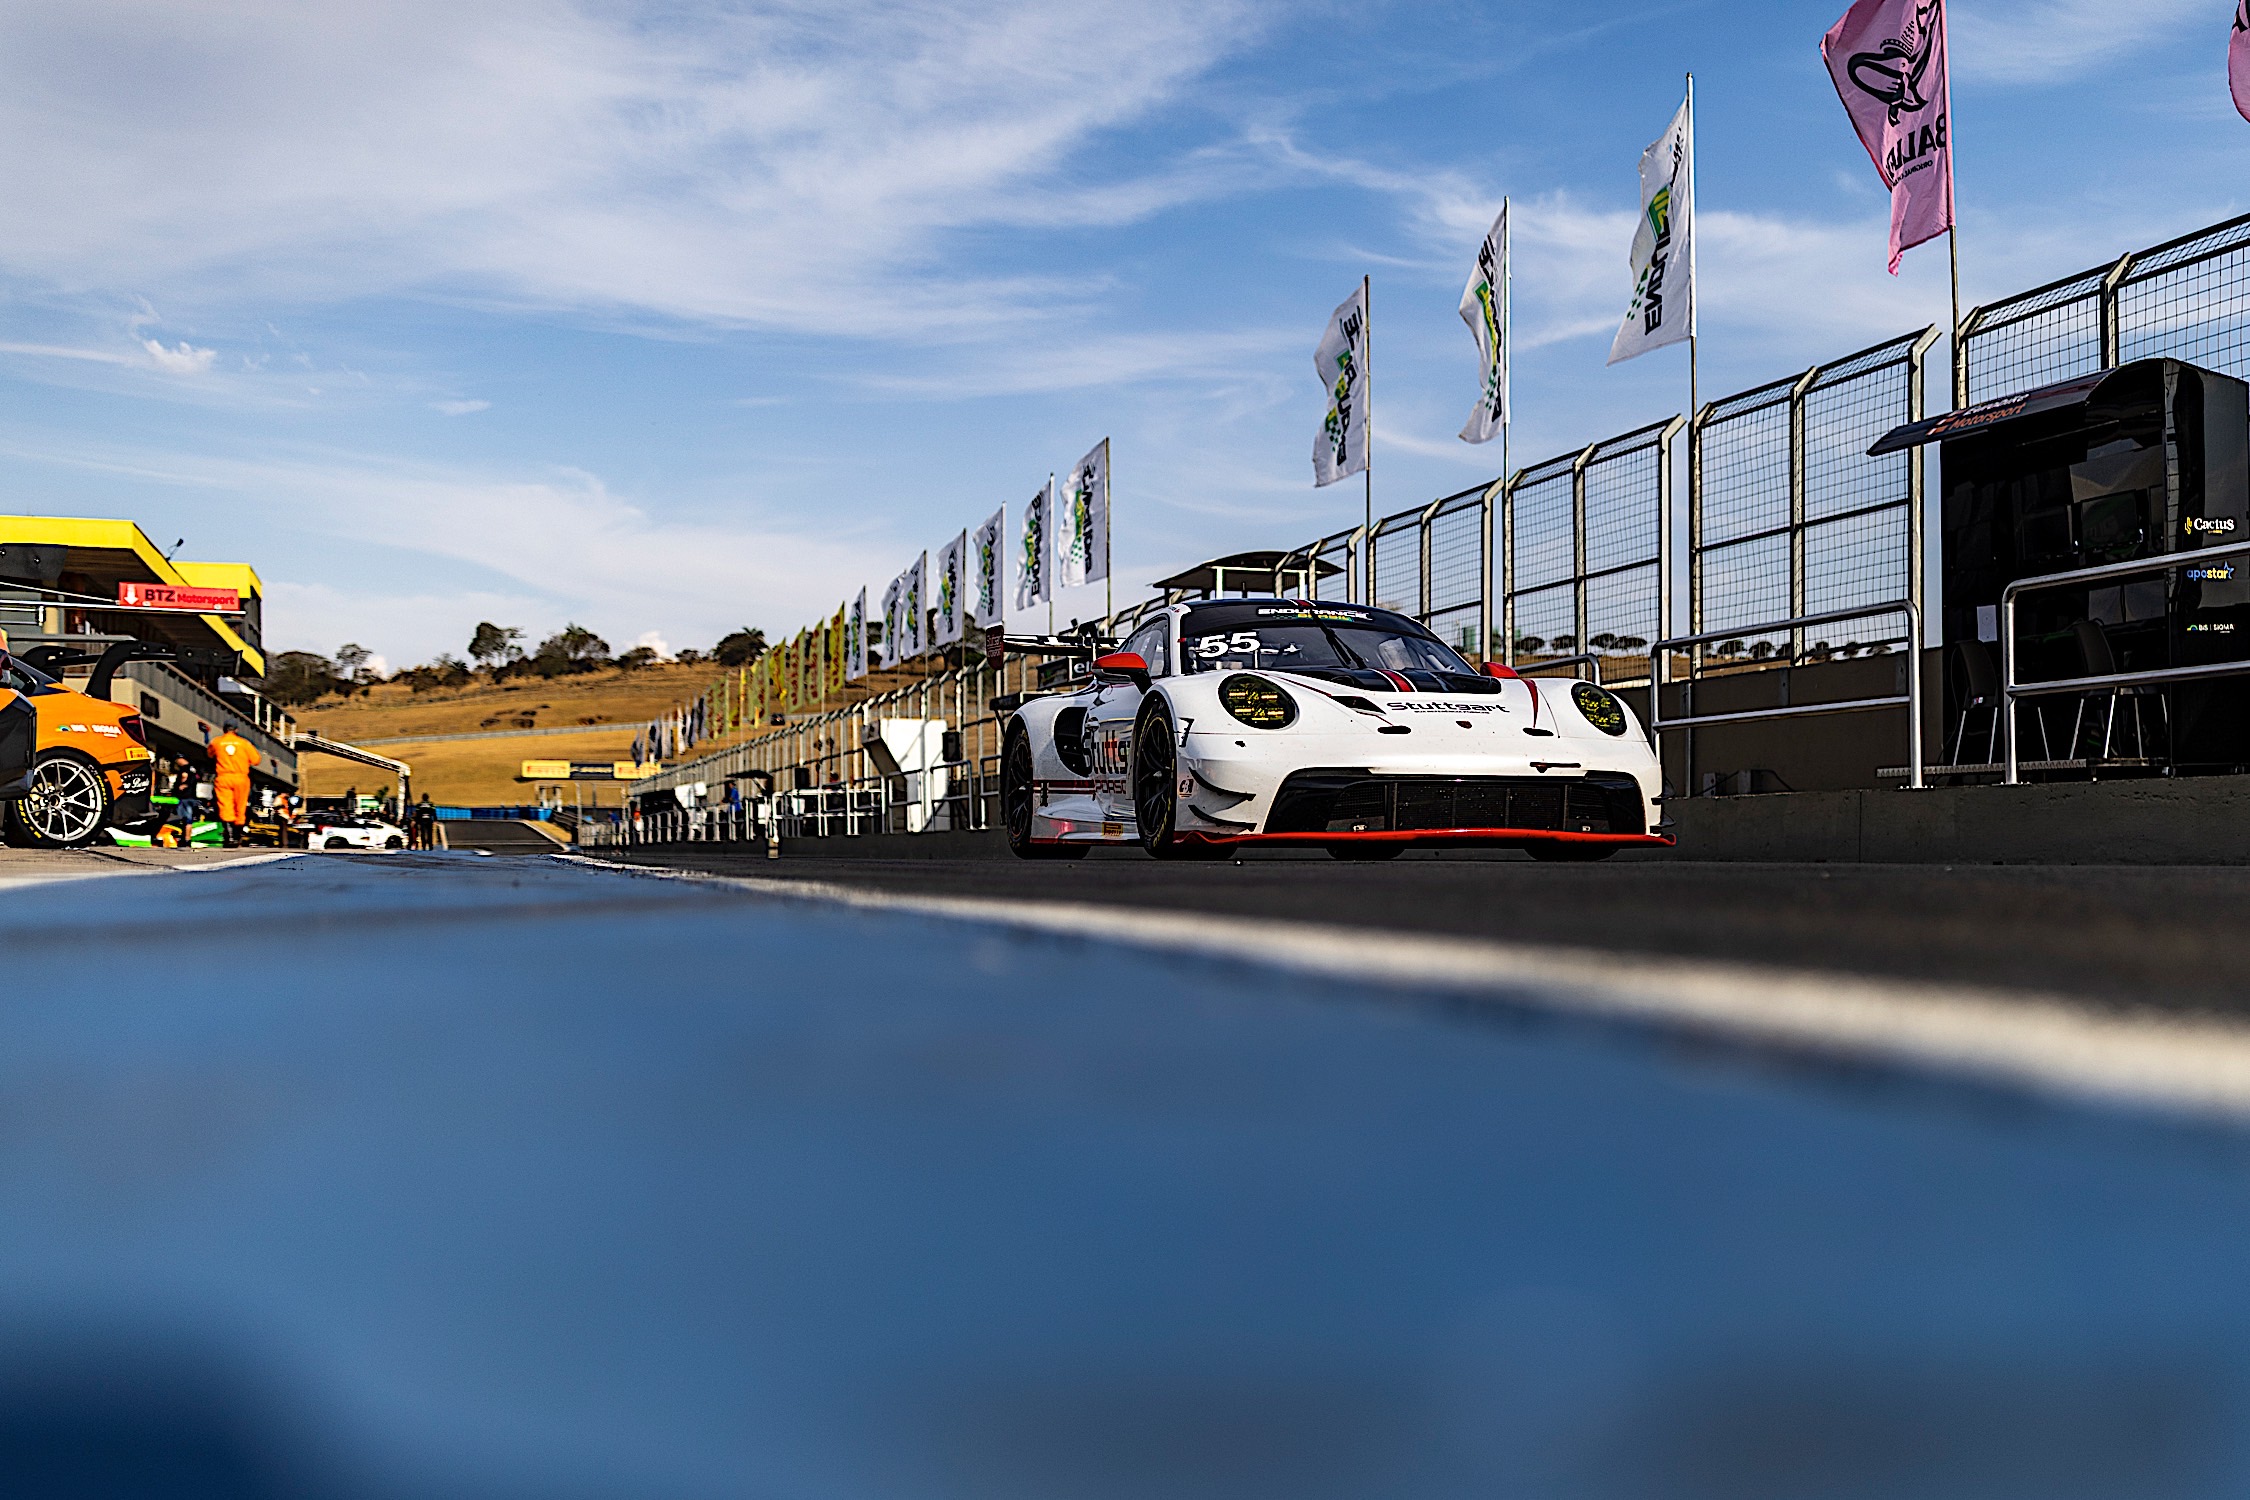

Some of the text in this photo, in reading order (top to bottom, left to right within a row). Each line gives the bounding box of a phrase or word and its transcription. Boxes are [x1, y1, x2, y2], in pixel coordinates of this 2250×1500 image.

[1948, 402, 2027, 431] Motorsport
[2186, 567, 2230, 582] apostar
[144, 588, 235, 605] BTZ Motorsport
[1198, 631, 1261, 658] 55
[1073, 661, 1093, 674] el
[1386, 701, 1510, 713] Stuttgart
